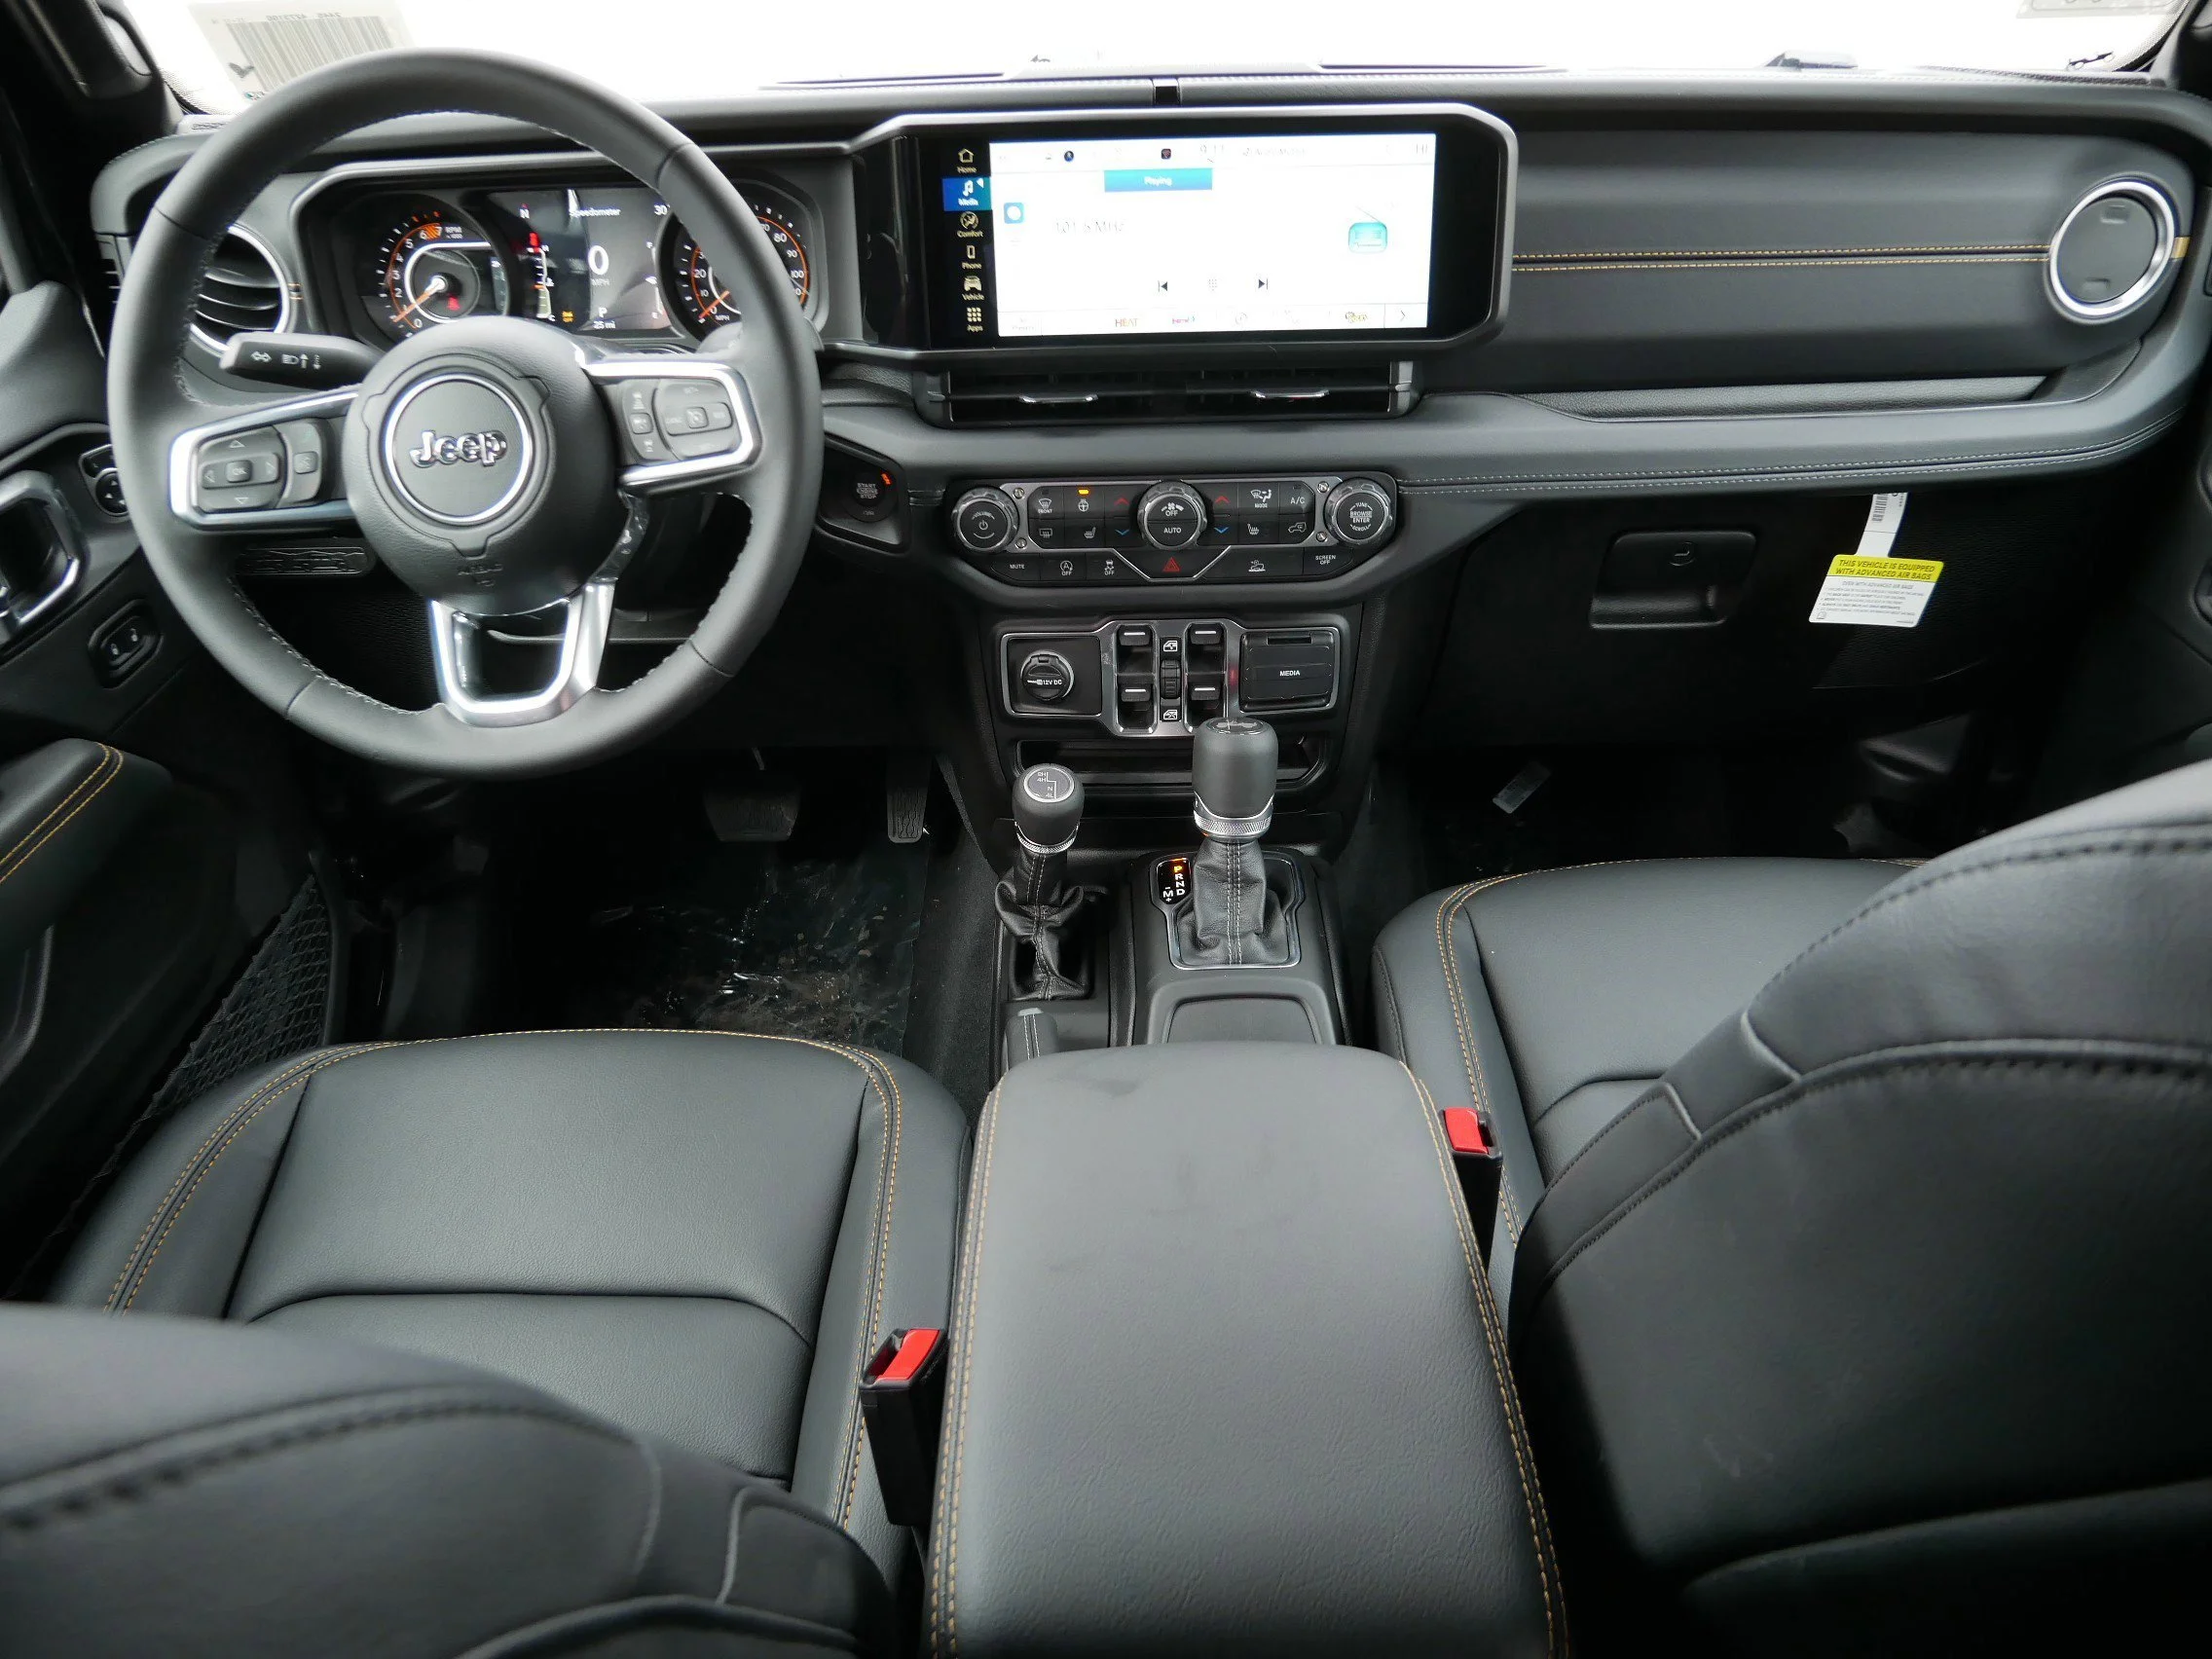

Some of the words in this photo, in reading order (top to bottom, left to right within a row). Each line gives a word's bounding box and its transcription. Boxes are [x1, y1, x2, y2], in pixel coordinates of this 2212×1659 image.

[958, 198, 979, 206] Media
[773, 233, 788, 242] 80
[957, 230, 983, 239] Comfort
[405, 239, 414, 248] 5
[787, 249, 798, 258] 90
[587, 244, 609, 276] 0
[392, 270, 401, 280] 3
[394, 287, 402, 297] 2
[598, 307, 608, 318] P
[414, 318, 423, 328] 0
[409, 429, 507, 468] Jeep
[1290, 497, 1306, 505] A/C
[1164, 509, 1178, 518] OFF
[1839, 559, 1856, 568] THIS
[1858, 561, 1889, 570] VEHICLE
[1898, 564, 1936, 572] EQUIPPED
[1174, 872, 1184, 881] R
[1162, 889, 1174, 898] M
